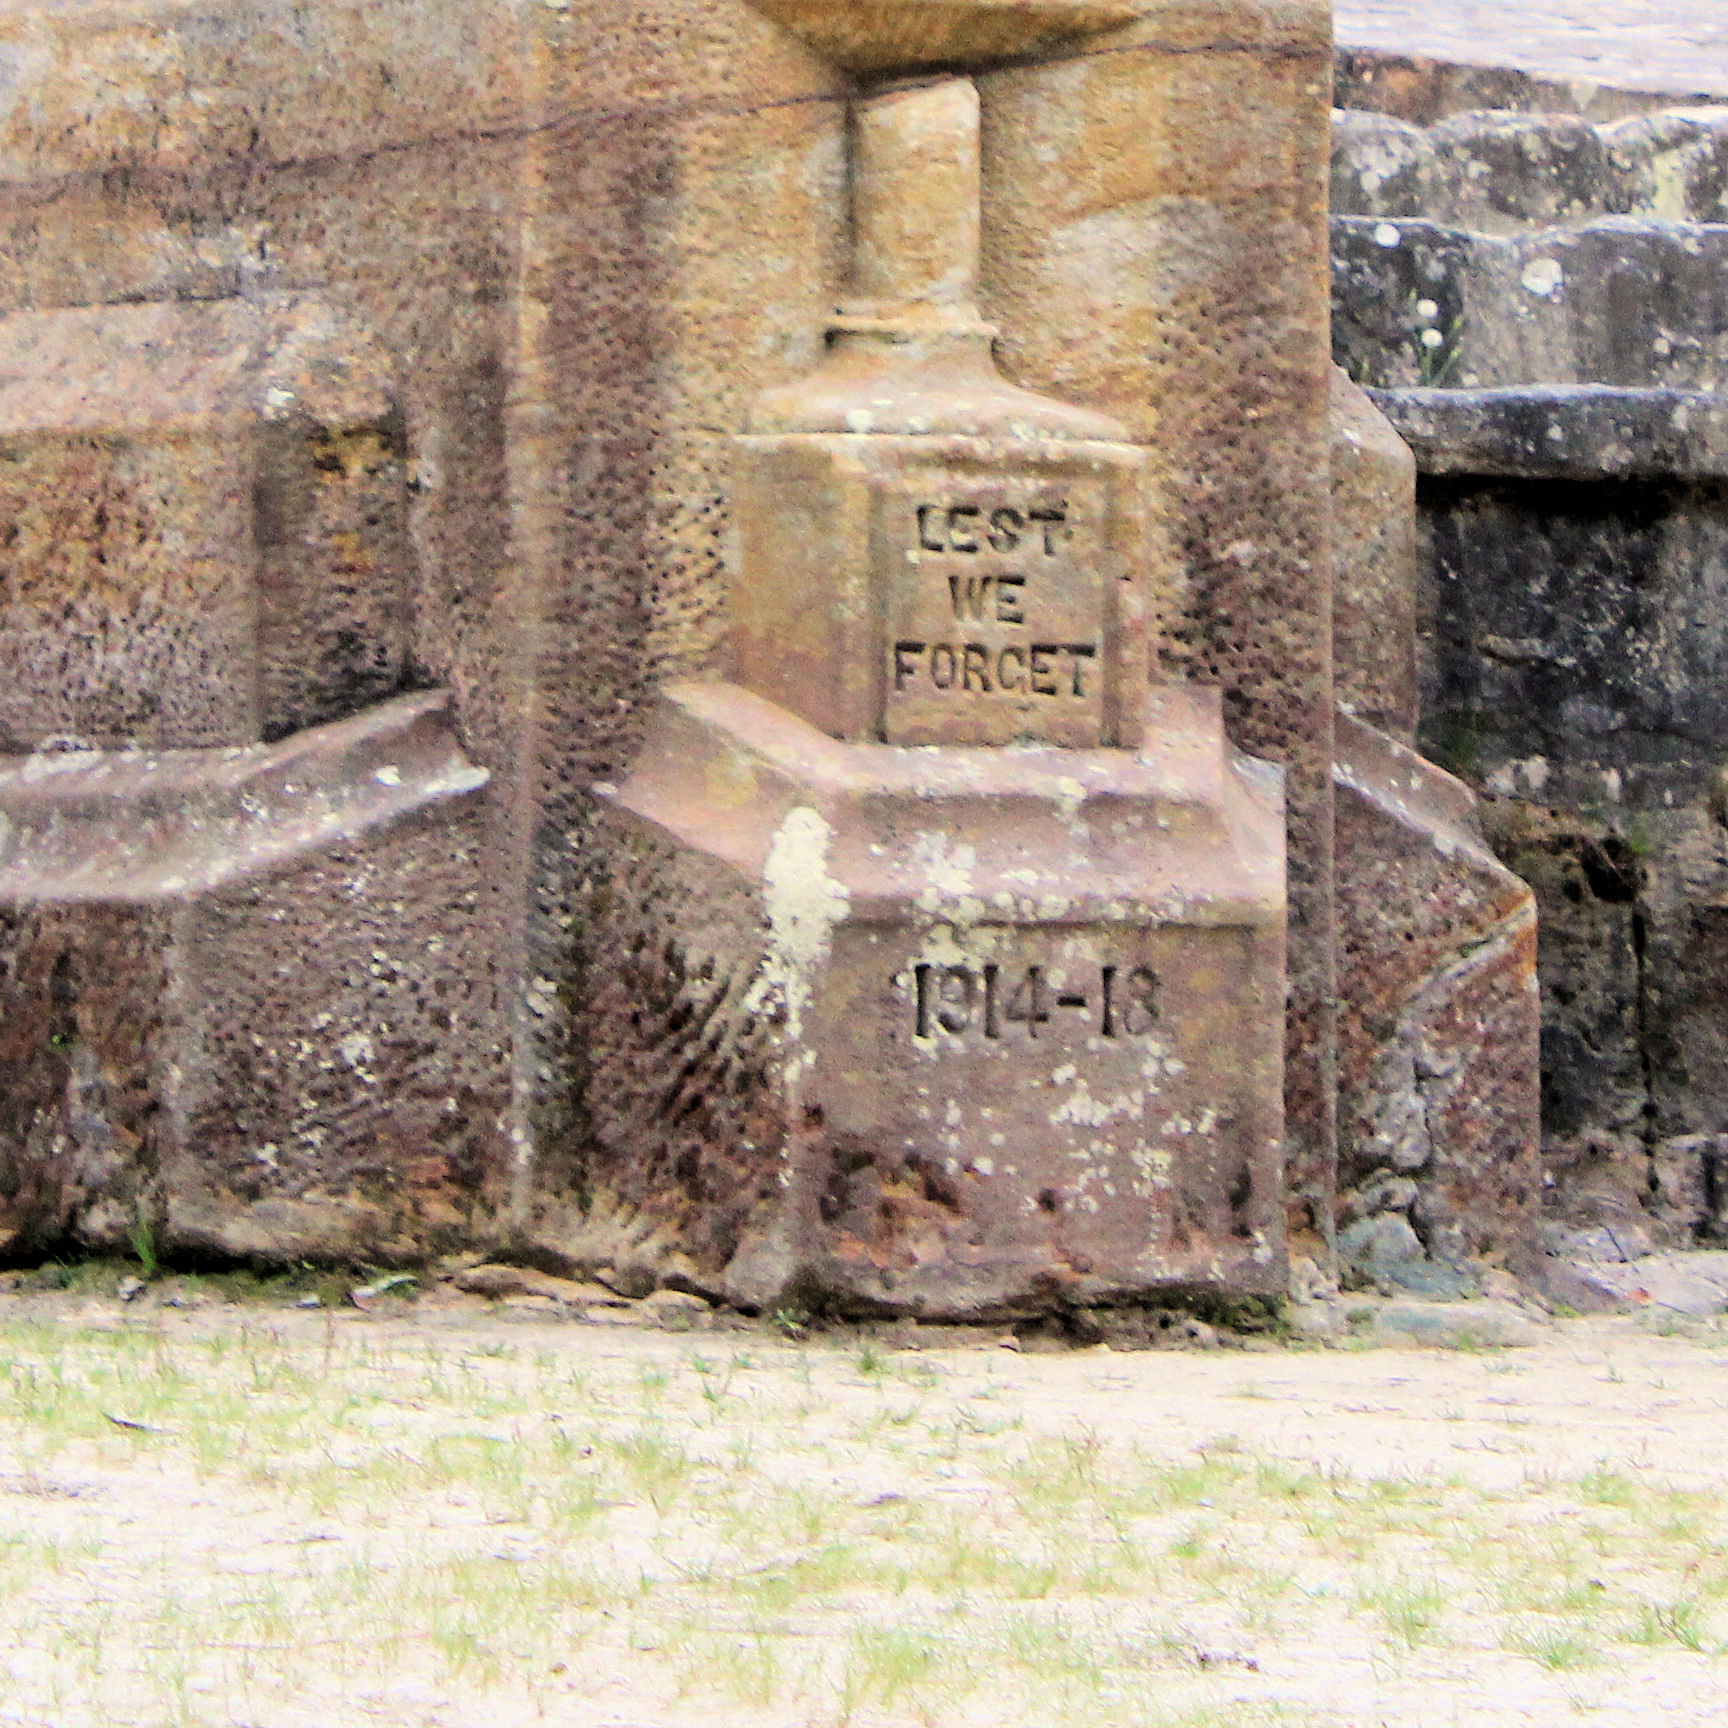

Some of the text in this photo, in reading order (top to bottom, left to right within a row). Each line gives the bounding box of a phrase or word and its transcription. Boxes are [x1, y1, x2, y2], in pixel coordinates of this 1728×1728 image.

[916, 503, 1068, 557] LEST
[948, 574, 1026, 624] WE
[894, 639, 1096, 697] FORGET
[914, 963, 1160, 1039] 1914-18
